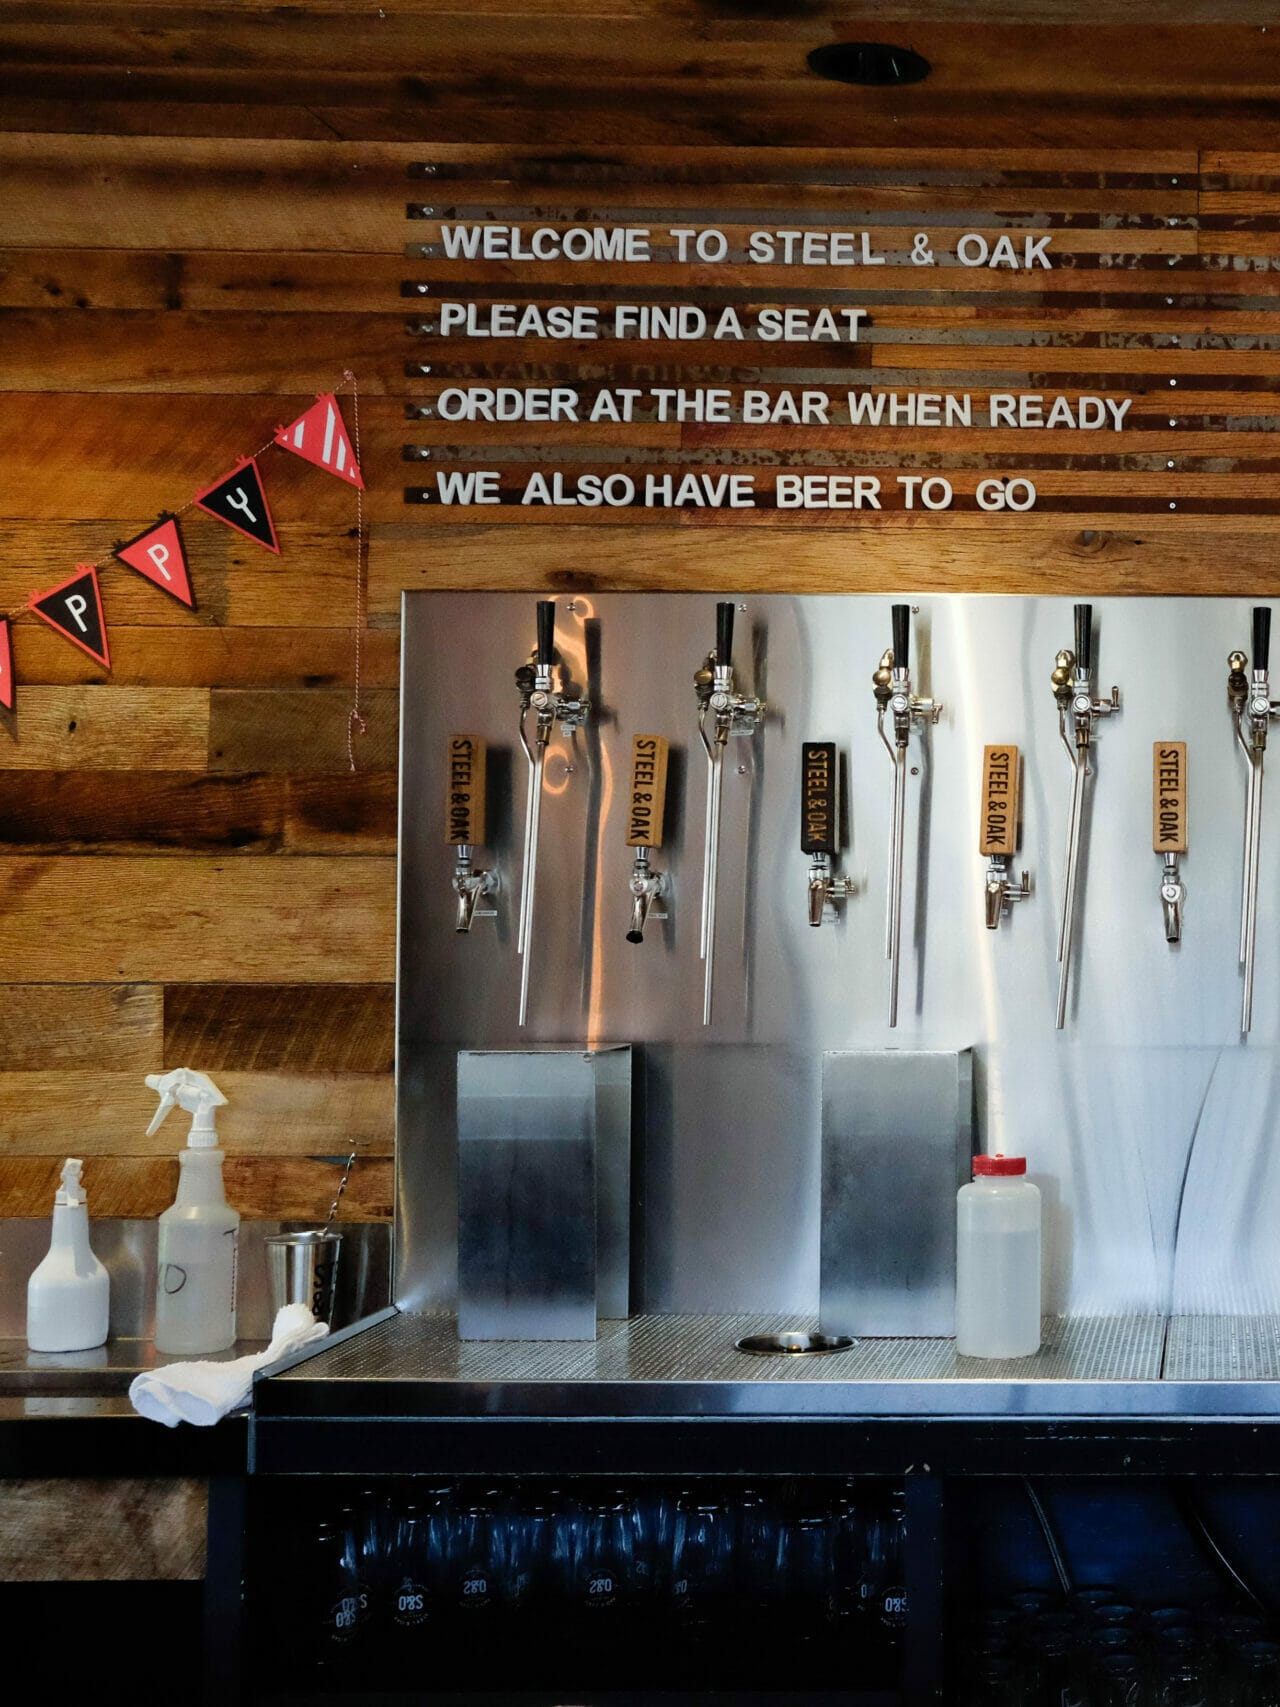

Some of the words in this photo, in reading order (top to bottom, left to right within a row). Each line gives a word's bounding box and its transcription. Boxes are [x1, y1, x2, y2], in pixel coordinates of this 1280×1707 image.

[441, 225, 650, 262] WELCOME
[670, 229, 728, 263] TO
[749, 231, 886, 266] STEEL
[910, 233, 935, 267] &
[957, 233, 1053, 270] OAK
[440, 303, 600, 340] PLEASE
[615, 305, 706, 340] FIND
[713, 307, 745, 341] A
[757, 308, 868, 343] SEAT
[437, 387, 579, 423] ORDER
[589, 388, 642, 423] AT
[650, 388, 731, 424] THE
[743, 389, 830, 425] BAR
[848, 391, 972, 428] WHEN
[990, 393, 1133, 432] READY
[225, 486, 257, 523] Y
[436, 470, 501, 506] WE
[521, 471, 636, 507] ALSO
[645, 473, 756, 509] HAVE
[776, 474, 883, 510] BEER
[896, 475, 953, 511] TO
[975, 477, 1037, 513] GO
[146, 543, 172, 581] P
[64, 594, 88, 633] P
[451, 739, 472, 789] STEEL
[633, 739, 656, 789] STEEL
[807, 750, 828, 796] STEEL
[988, 752, 1009, 798] STEEL
[1159, 749, 1179, 796] STEEL
[451, 792, 471, 805] &
[632, 791, 653, 804] &
[807, 799, 827, 809] &
[987, 801, 1007, 812] &
[1159, 798, 1179, 809] &
[450, 805, 470, 841] OAK
[629, 805, 651, 840] OAK
[807, 812, 827, 842] OAK
[986, 814, 1007, 846] OAK
[1159, 812, 1179, 843] OAK
